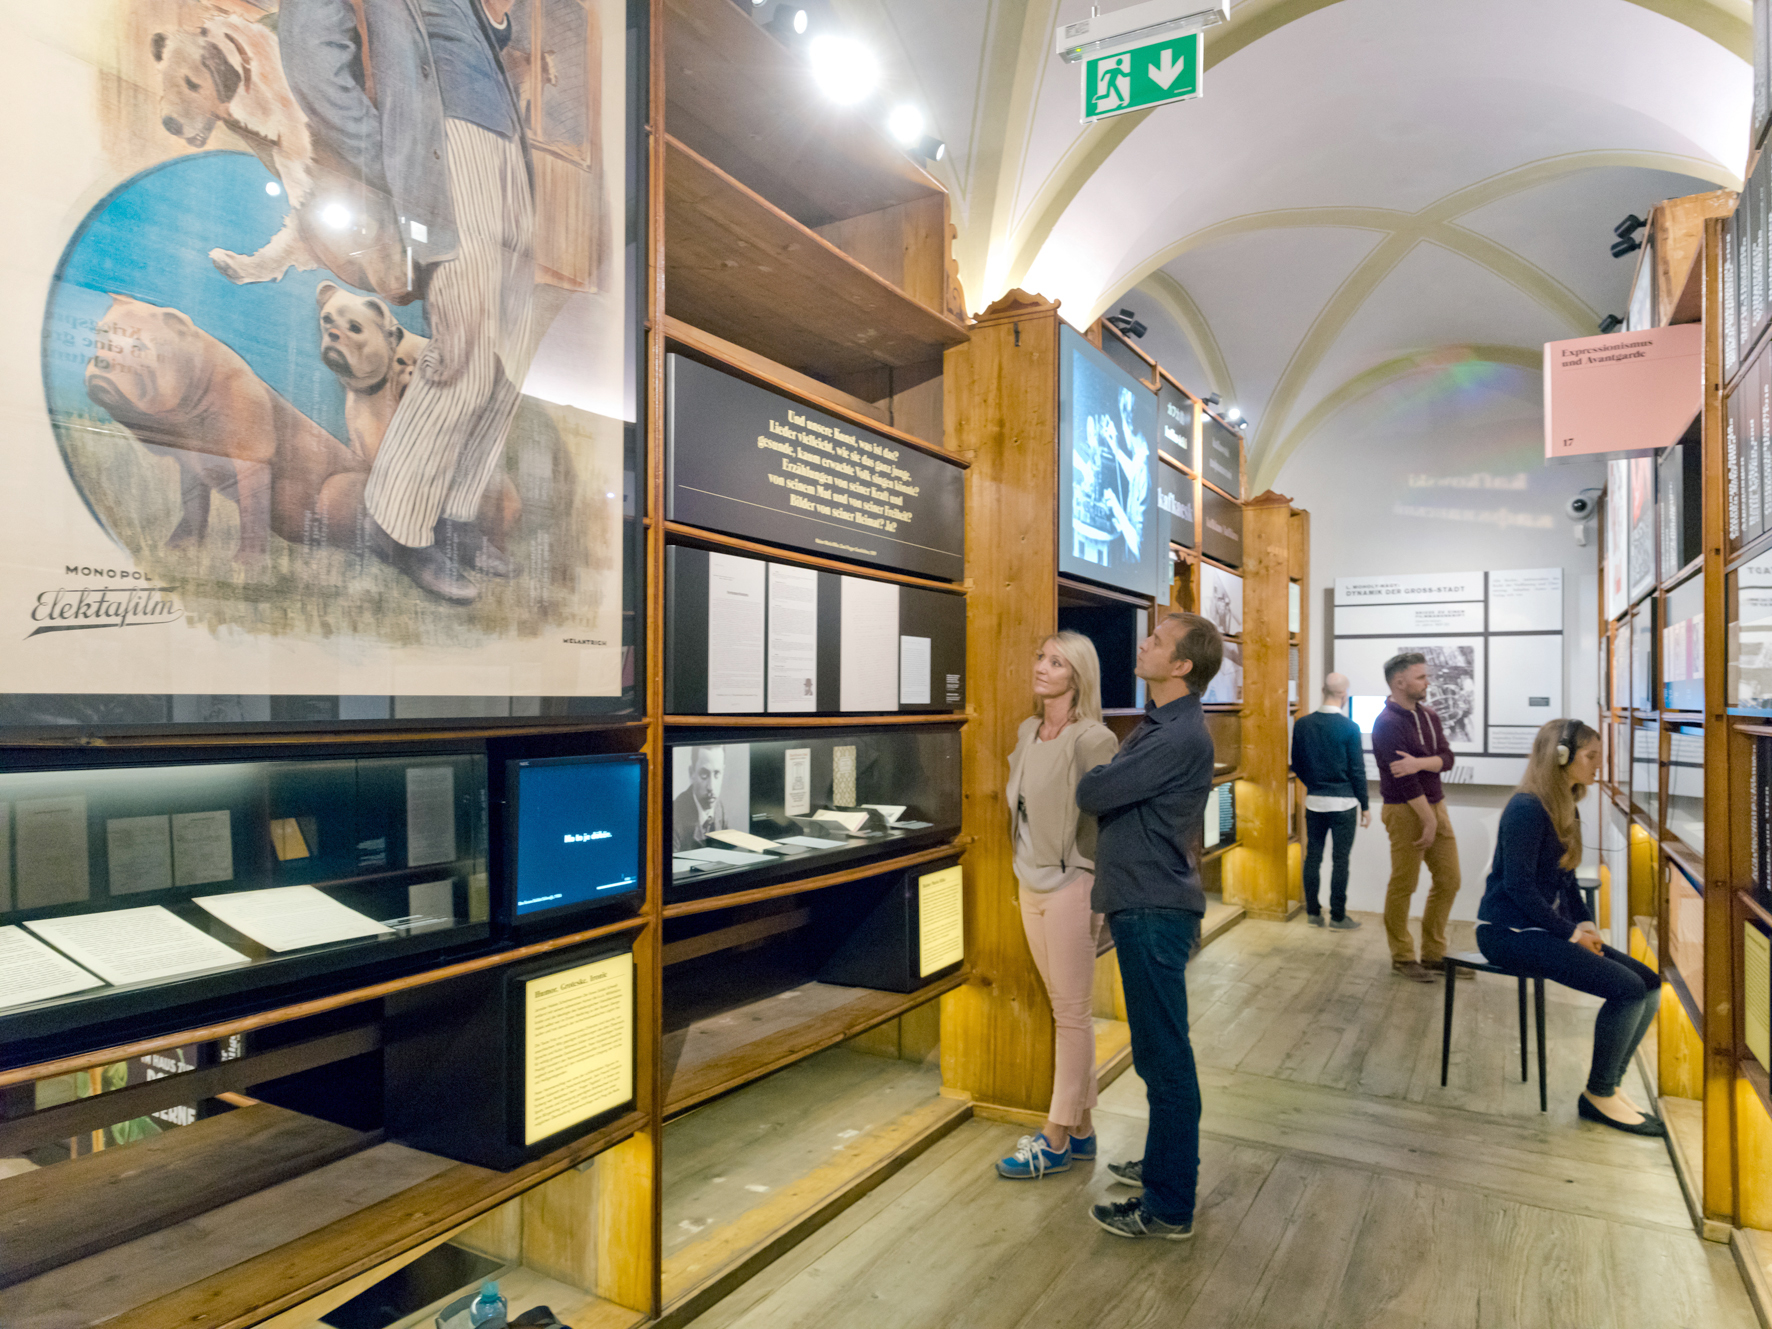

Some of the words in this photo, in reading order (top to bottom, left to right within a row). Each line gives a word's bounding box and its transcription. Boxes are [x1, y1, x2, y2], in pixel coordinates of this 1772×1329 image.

[1562, 339, 1653, 359] Expressionismus
[1562, 358, 1582, 367] und
[1585, 351, 1646, 364] Avantgarde
[769, 420, 797, 440] Lieder
[798, 432, 835, 455] vielleicht,
[836, 447, 850, 458] wie
[850, 451, 861, 462] sie
[861, 455, 874, 467] das
[875, 461, 891, 473] ganz
[788, 410, 806, 427] Und
[806, 421, 833, 437] unsere
[834, 428, 858, 447] Kunst,
[858, 440, 872, 452] was
[873, 443, 882, 456] ist
[883, 448, 899, 461] das?
[1563, 438, 1574, 447] 17
[757, 436, 796, 457] gesunde,
[797, 447, 821, 464] kaum
[822, 458, 855, 475] erwachte
[855, 466, 871, 481] Volk
[872, 474, 893, 488] singen
[768, 474, 785, 486] von
[786, 479, 815, 495] seinem
[833, 494, 848, 504] und
[849, 497, 862, 508] von
[863, 502, 884, 514] seiner
[782, 458, 833, 484] Erzählungen
[834, 478, 848, 489] von
[849, 482, 871, 496] seiner
[871, 487, 889, 502] Kraft
[890, 495, 903, 506] und
[790, 494, 815, 511] Bilder
[816, 504, 831, 515] von
[832, 508, 854, 521] seiner
[855, 512, 884, 529] Heimat?
[65, 565, 152, 581] MONOPOL
[1404, 586, 1465, 594] GROSS-STADT
[28, 586, 180, 630] Elektafilm
[563, 638, 606, 646] MELANTRICH
